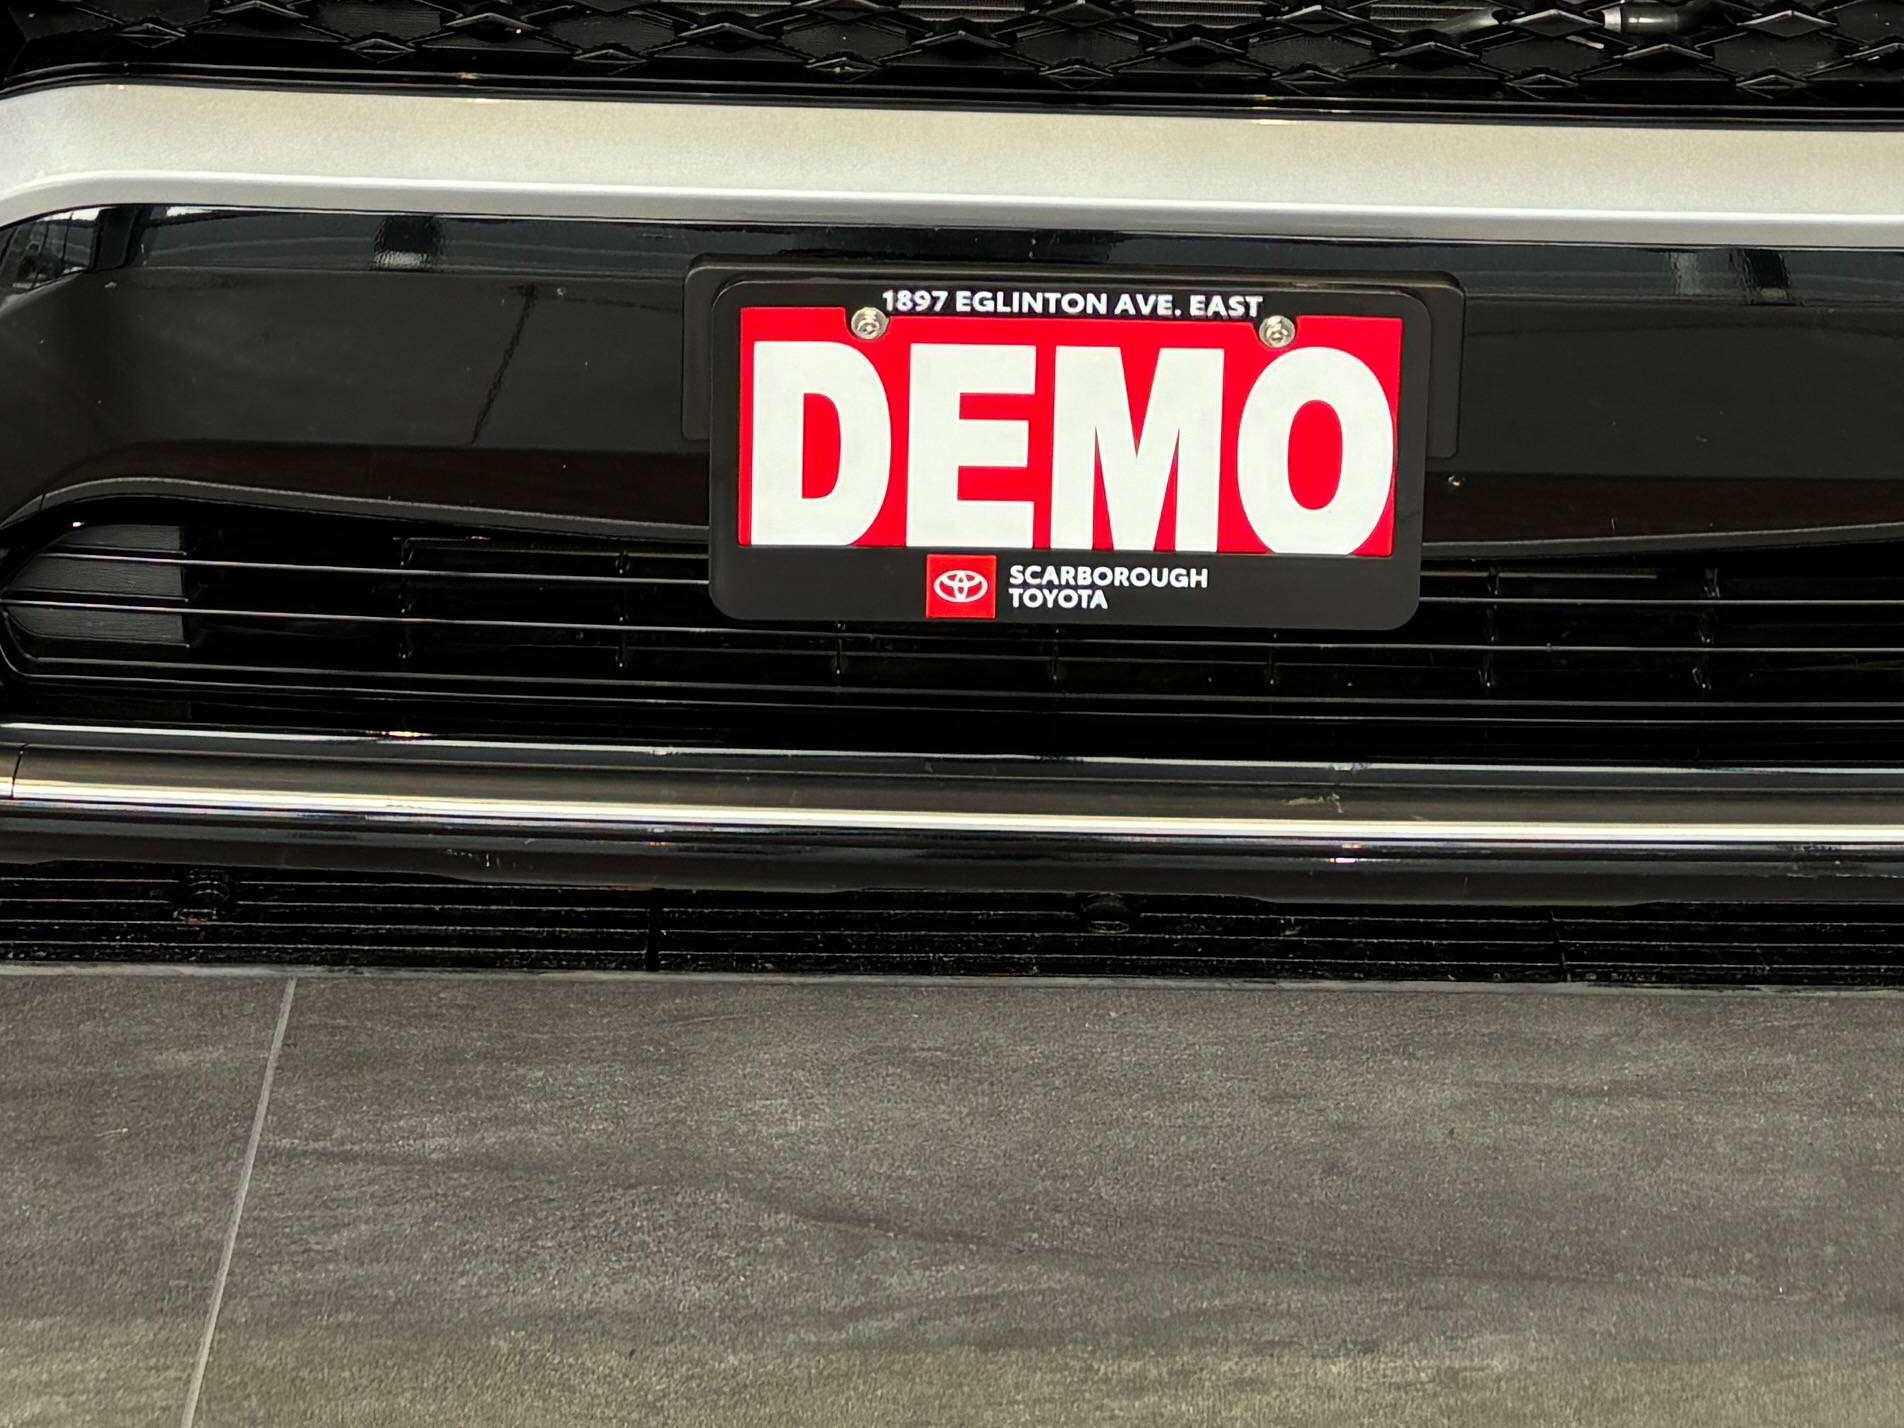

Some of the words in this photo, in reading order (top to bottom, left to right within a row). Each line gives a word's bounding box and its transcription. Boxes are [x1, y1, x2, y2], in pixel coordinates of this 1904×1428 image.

[882, 289, 949, 314] 1897
[955, 291, 1107, 317] EGLINTON
[1114, 294, 1183, 318] AVE.
[1189, 296, 1263, 319] EAST
[750, 339, 1395, 556] DEMO
[1007, 564, 1209, 591] SCARBOROUGH
[1007, 588, 1109, 610] TOYOTA
